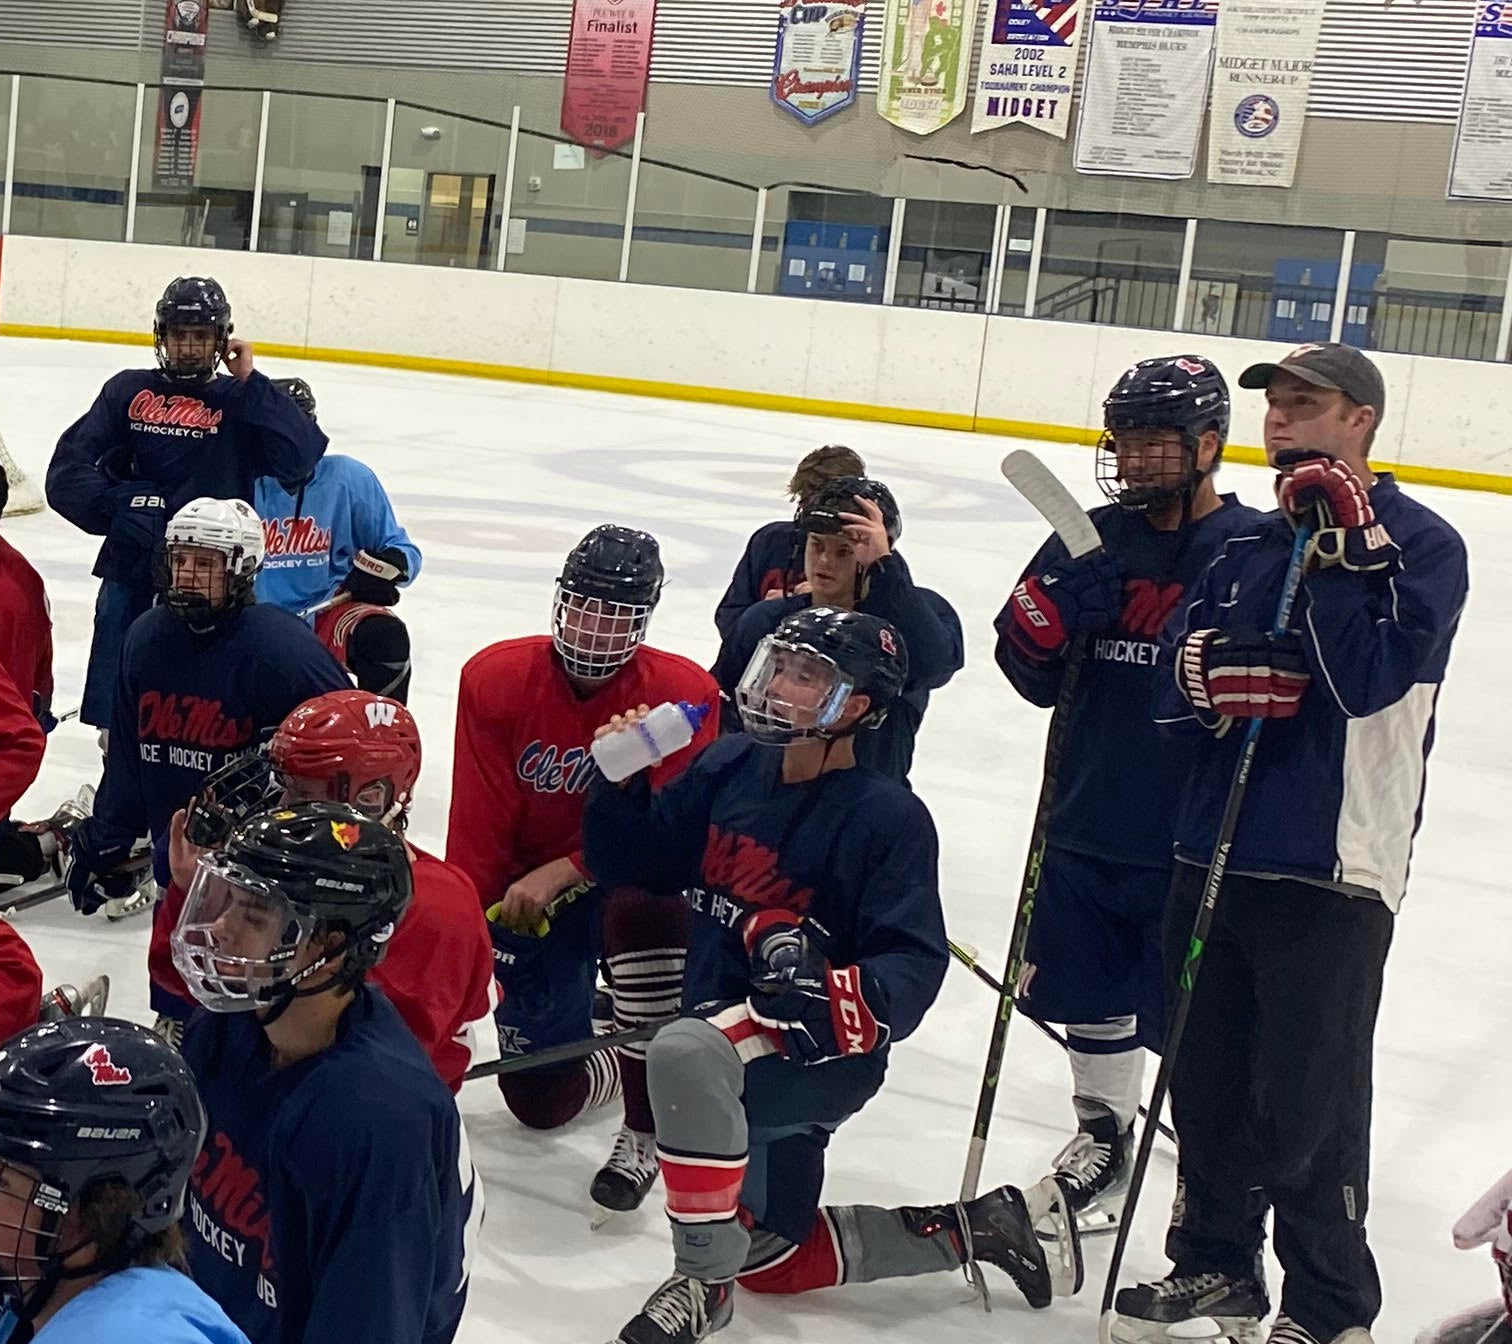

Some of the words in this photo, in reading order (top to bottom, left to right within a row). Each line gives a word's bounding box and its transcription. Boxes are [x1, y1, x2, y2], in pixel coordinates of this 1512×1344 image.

[587, 19, 639, 34] Finalist
[1014, 47, 1045, 61] 2002
[1217, 56, 1266, 71] MIDGET
[990, 63, 1019, 77] SAHA
[1022, 65, 1054, 78] LEVEL
[1058, 66, 1067, 78] 2
[987, 96, 1059, 120] MIDGET
[128, 388, 171, 424] Ole
[162, 394, 223, 429] Miss
[143, 424, 191, 437] HOCKEY
[281, 515, 332, 556] Miss
[263, 558, 302, 569] OCKEY
[1093, 637, 1161, 666] HOCKEY
[137, 690, 185, 743] Ole
[364, 700, 398, 730] W
[139, 742, 162, 764] ICE
[168, 745, 213, 773] HOCKEY
[314, 877, 366, 894] BAUER
[290, 956, 327, 986] CCM
[831, 968, 865, 1055] CCM
[76, 1126, 142, 1141] BAUER
[33, 1197, 69, 1216] CCM
[190, 1190, 246, 1268] HOCKEY
